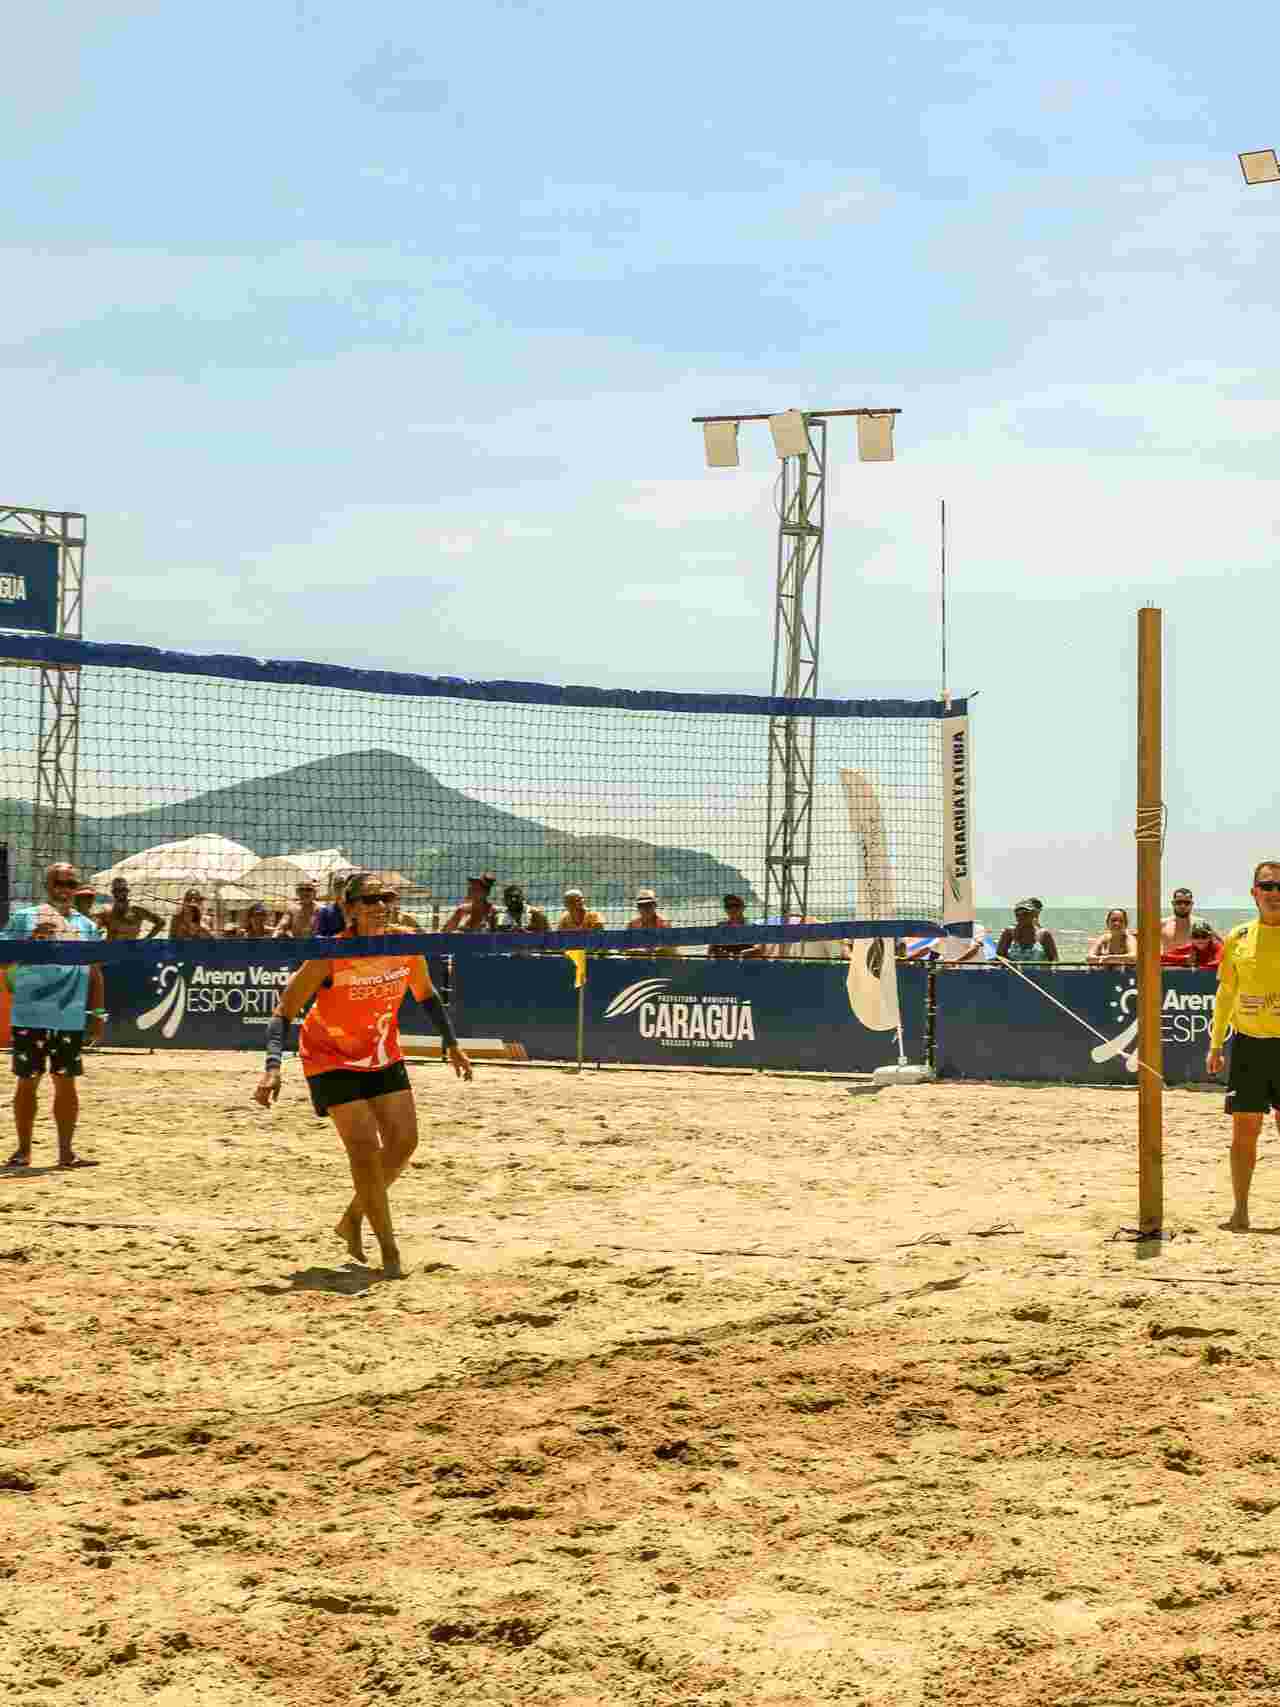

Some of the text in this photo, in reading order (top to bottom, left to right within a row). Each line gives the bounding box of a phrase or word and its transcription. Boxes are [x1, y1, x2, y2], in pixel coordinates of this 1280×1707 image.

[192, 965, 288, 985] Arena Verã
[186, 988, 283, 1013] ESPORTI
[1162, 988, 1217, 1010] Aren
[640, 1000, 755, 1041] CARAGUÁ
[1160, 1014, 1232, 1042] ESPO
